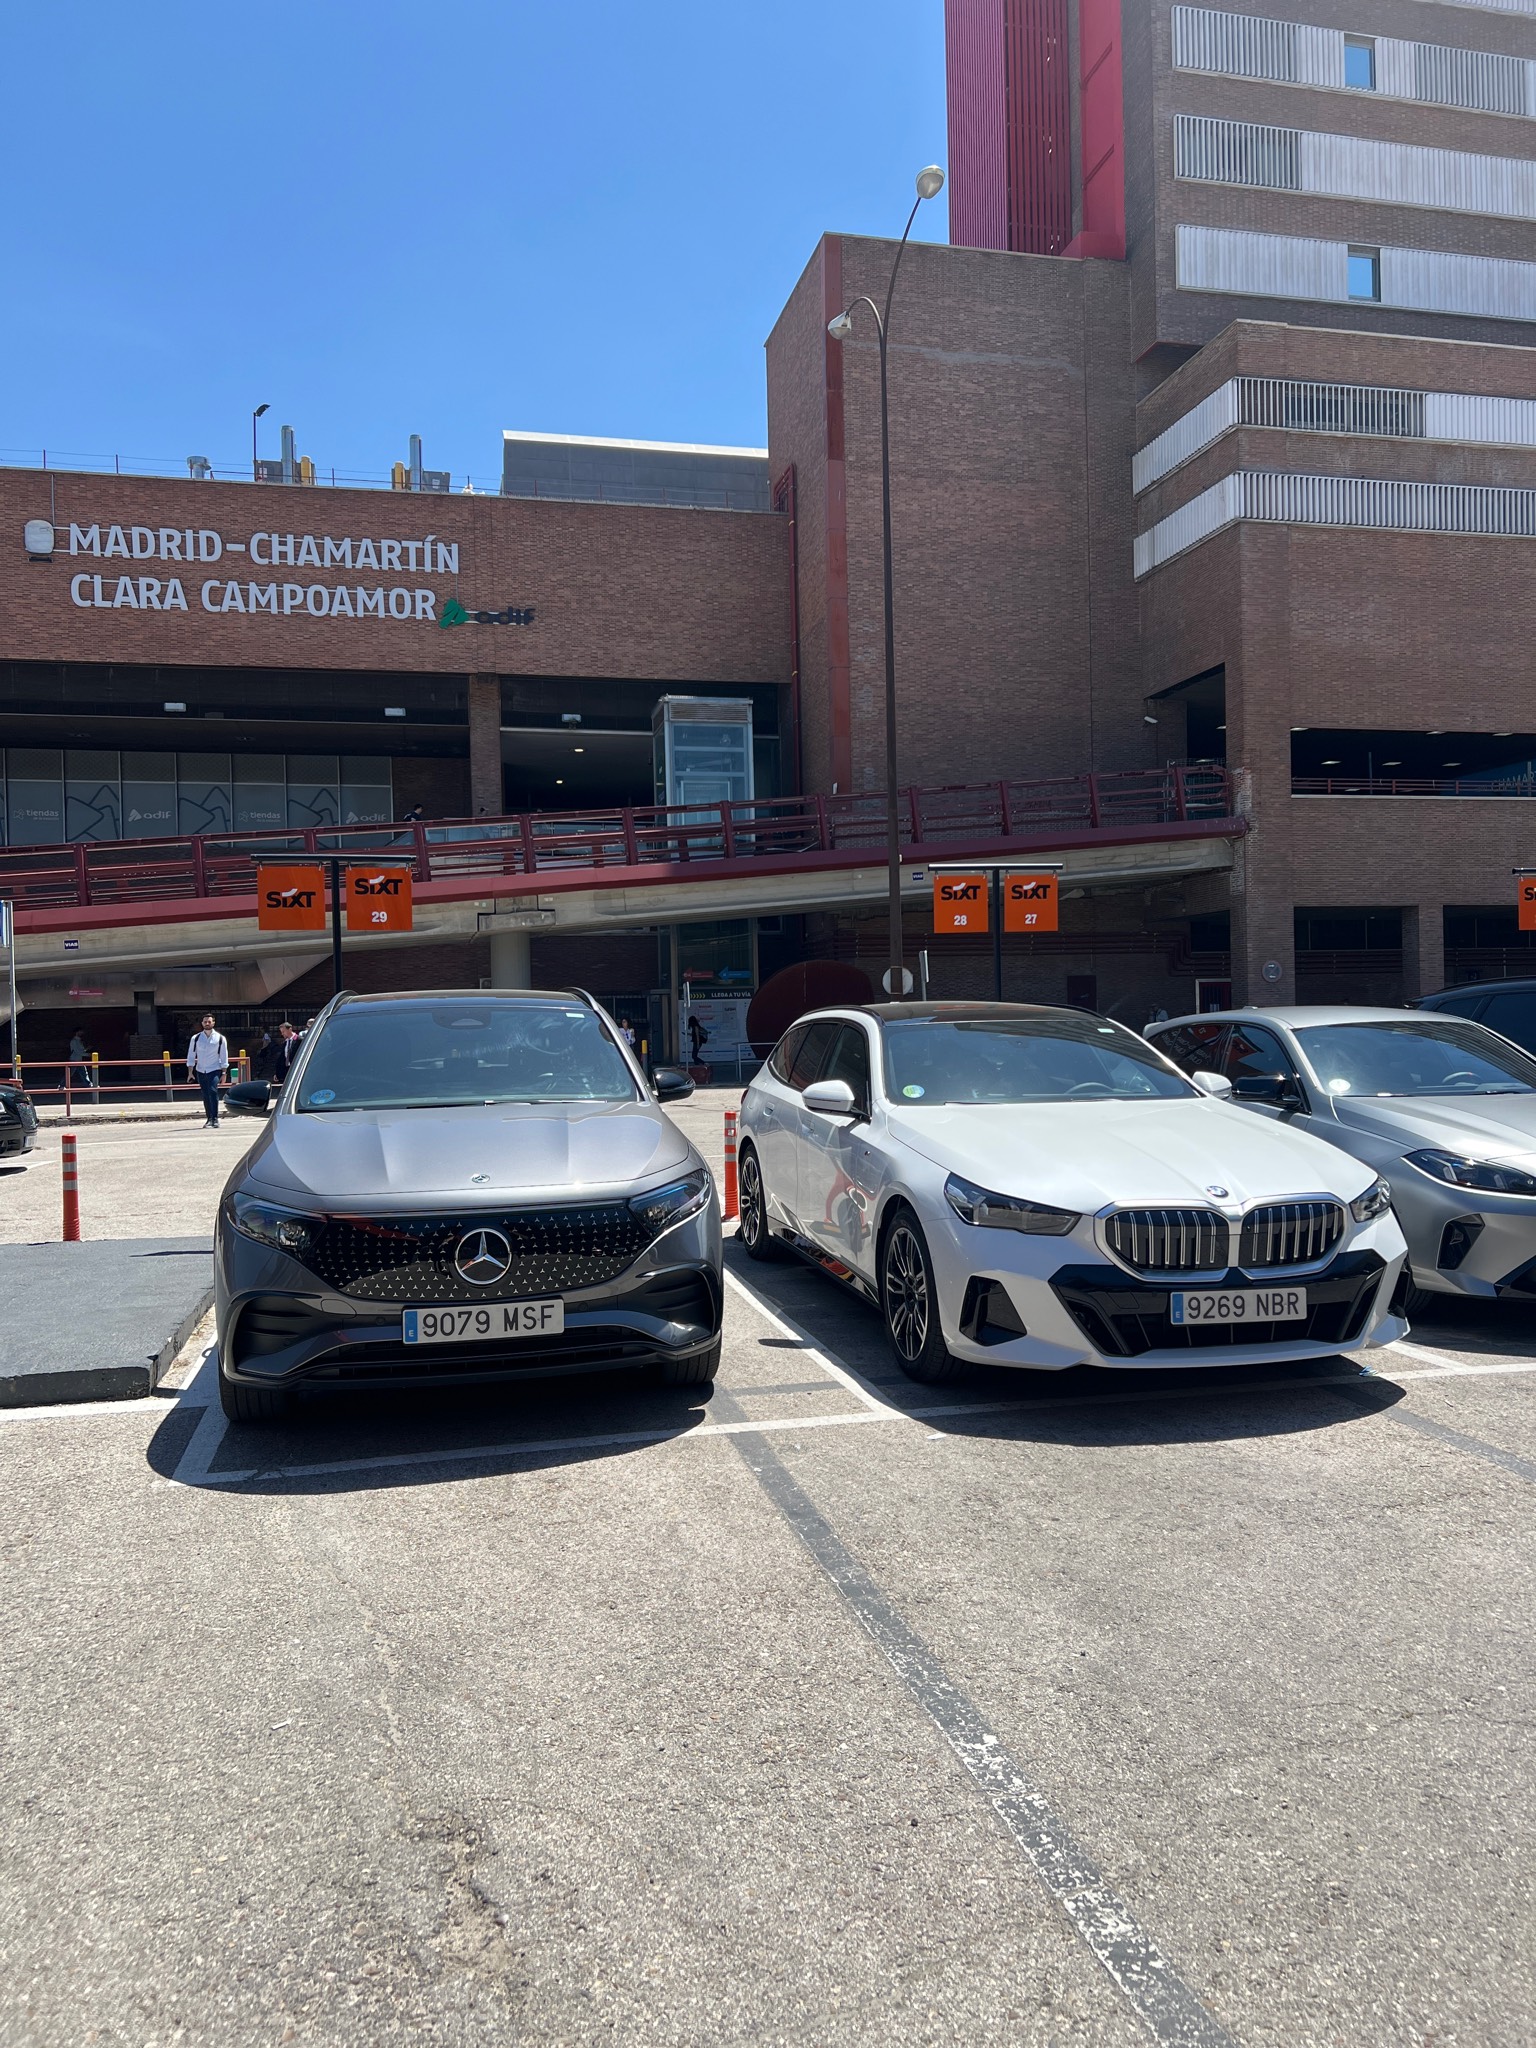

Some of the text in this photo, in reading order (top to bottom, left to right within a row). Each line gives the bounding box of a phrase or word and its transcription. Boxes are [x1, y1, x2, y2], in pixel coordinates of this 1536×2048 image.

[69, 522, 459, 574] MADRID-CHAMARTÍN
[70, 573, 437, 621] CLARA CAMPOAMOR
[475, 606, 536, 625] adif
[26, 809, 59, 817] tiendas
[143, 810, 172, 819] adif
[250, 811, 281, 819] tiendas
[360, 813, 387, 822] adif
[371, 911, 388, 923] 29
[953, 914, 968, 926] 28
[1024, 914, 1038, 925] 27
[1175, 1292, 1299, 1320] E 9269 NBR
[408, 1304, 555, 1338] E 9079 MSF
